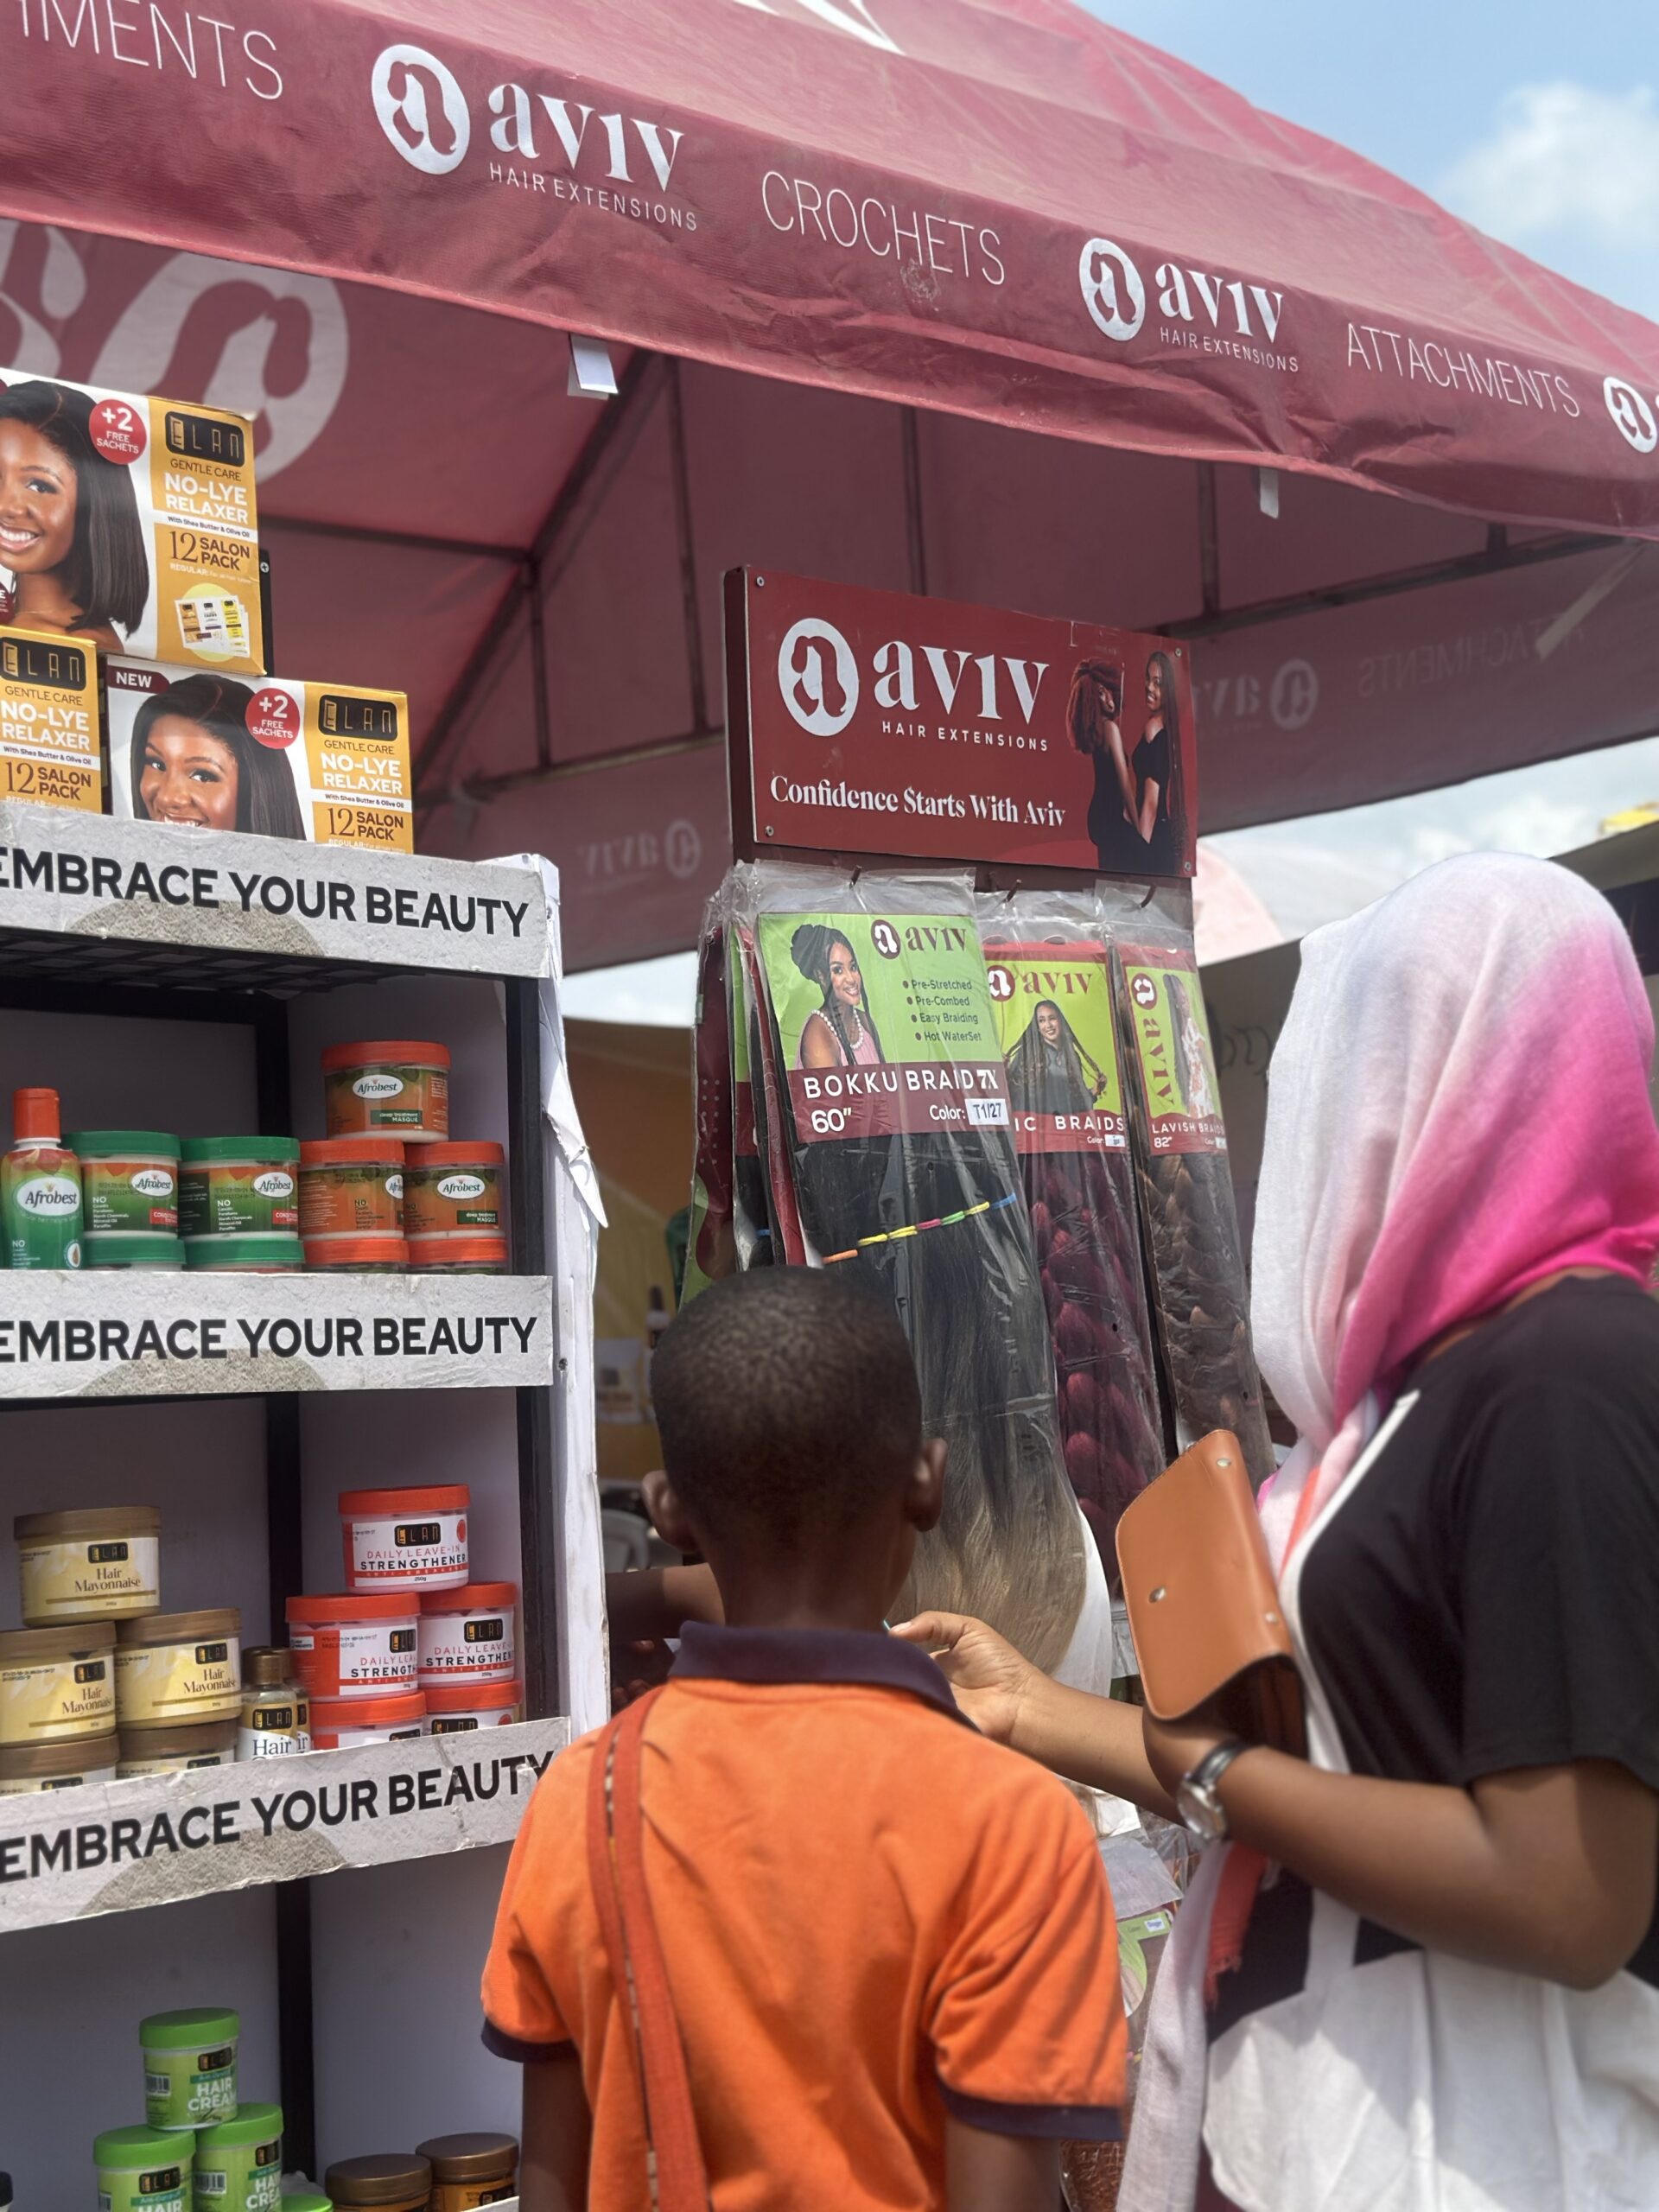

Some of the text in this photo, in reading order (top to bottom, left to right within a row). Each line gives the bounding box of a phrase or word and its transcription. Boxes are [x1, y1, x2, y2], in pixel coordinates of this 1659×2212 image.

[489, 162, 697, 232] HAIR EXTENSIONS
[762, 170, 1005, 285] CROCHETS
[1160, 327, 1299, 372] HAIR EXTENSIONS
[1347, 322, 1580, 417] ATTACHMENTS
[101, 407, 133, 432] +2
[96, 437, 139, 454] SACHETS
[106, 430, 130, 443] FREE
[170, 458, 241, 481] GENTLE CARE
[164, 472, 248, 506] NO-LYE
[165, 493, 249, 525] RELAXER
[168, 531, 251, 563] 12 SALON
[200, 551, 240, 571] PACK
[116, 671, 152, 689] NEW
[5, 685, 83, 706] GENTLE CARE
[0, 699, 90, 732] NO-LYE
[259, 695, 289, 719] +2
[251, 727, 294, 739] SACHETS
[261, 719, 284, 730] FREE
[2, 721, 91, 751] RELAXER
[882, 721, 1048, 752] HAIR EXTENSIONS
[3, 746, 20, 754] With
[21, 747, 37, 757] Shea
[38, 750, 59, 760] Butter
[66, 754, 82, 765] Olive
[82, 757, 92, 766] Oil
[324, 739, 395, 755] GENTLE CARE
[320, 752, 402, 778] NO-LYE
[5, 760, 92, 795] 12 SALON
[323, 772, 404, 796] RELAXER
[38, 781, 81, 801] PACK
[380, 799, 396, 808] Olive
[770, 775, 1066, 827] Confidence Starts With Aviv
[327, 807, 404, 837] 12 SALON
[357, 824, 395, 842] PACK
[228, 871, 356, 922] YOUR
[366, 887, 529, 939] BEAUTY
[911, 980, 973, 990] Pre-Stretched
[915, 996, 970, 1007] Pre-Combed
[919, 1013, 979, 1025] Easy Braiding
[924, 1032, 982, 1042] Hot WaterSet
[357, 1083, 397, 1095] Afrobest
[803, 1069, 999, 1099] BOKKU BRAID 7X
[810, 1103, 1002, 1134] 60" Color: T1/27
[1054, 1116, 1124, 1131] BRAIDS
[1151, 1122, 1196, 1134] LAVISH
[137, 1178, 171, 1190] Afrobest
[259, 1180, 291, 1192] Afrobest
[442, 1182, 480, 1194] Afrobest
[25, 1190, 77, 1209] Afrobest
[12, 1239, 26, 1248] NO
[238, 1318, 364, 1357] YOUR
[374, 1317, 537, 1356] BEAUTY
[366, 1545, 461, 1559] DAILY LEAVE-IN
[360, 1554, 466, 1571] STRENGTHENER
[97, 1567, 123, 1580] Hair
[74, 1577, 142, 1594] Mayonnaise
[434, 1646, 471, 1656] DAILY
[360, 1656, 397, 1666] DAILY
[203, 1668, 225, 1681] Hair
[82, 1687, 102, 1701] Hair
[183, 1677, 236, 1695] Mayonnaise
[251, 1737, 292, 1756] Hair
[0, 1749, 555, 1885] EMBRACE YOUR BEAUTY
[196, 2076, 232, 2097] HAIR
